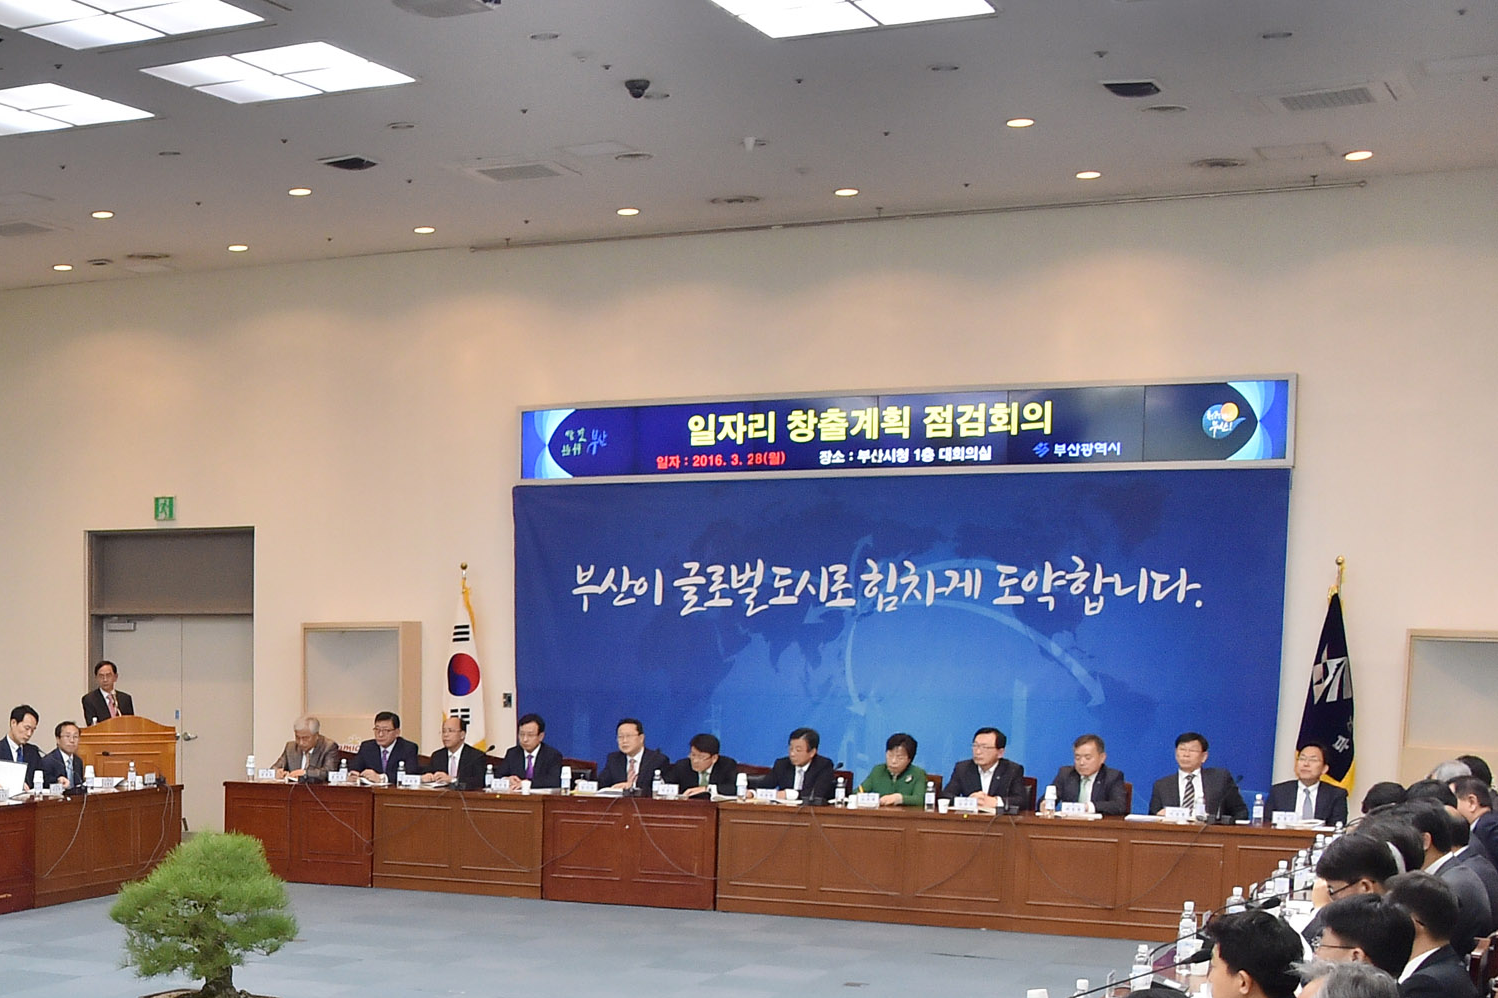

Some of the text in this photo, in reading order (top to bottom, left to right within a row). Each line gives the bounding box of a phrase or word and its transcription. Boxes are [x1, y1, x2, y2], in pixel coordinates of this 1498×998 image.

[687, 400, 1052, 446] 일자리 창출계획 점검회의
[819, 450, 845, 465] 장소
[857, 448, 909, 464] 부산시청
[913, 447, 935, 462] 1층
[938, 445, 992, 462] 대회의실
[1053, 441, 1122, 458] 부산광역시
[656, 455, 681, 469] 일자
[692, 454, 726, 467] 2016.
[730, 454, 743, 467] 3.
[747, 451, 786, 466] 28(월)
[572, 564, 664, 613] 부산이
[860, 558, 982, 612] 힘차게
[992, 555, 1202, 616] 도약합니다.
